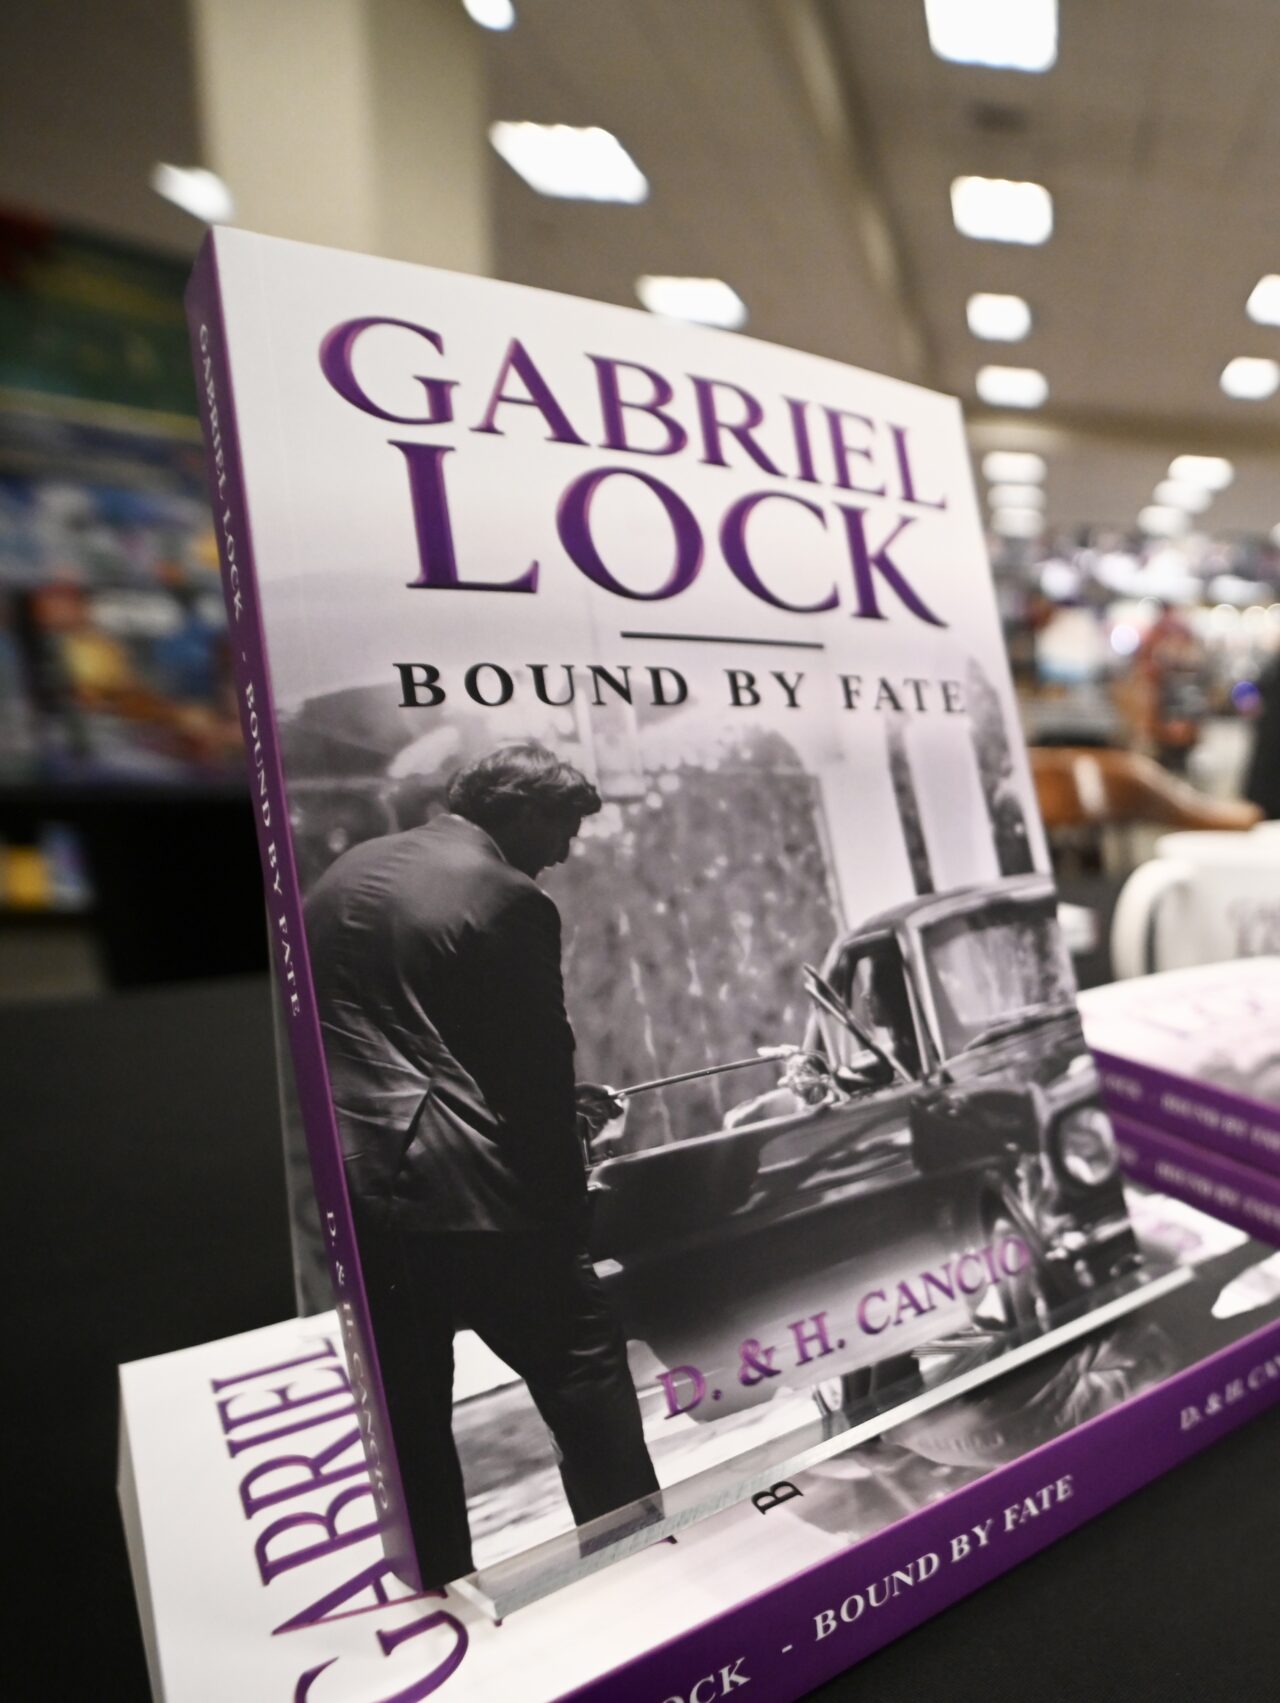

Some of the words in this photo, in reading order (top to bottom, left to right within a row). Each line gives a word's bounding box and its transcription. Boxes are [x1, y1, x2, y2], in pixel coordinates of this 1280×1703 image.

[319, 315, 948, 511] GABRIEL
[387, 439, 950, 628] LOCK
[199, 323, 226, 500] GABRIEL
[222, 508, 243, 623] LOCK
[245, 682, 271, 828] BOUND
[267, 841, 282, 895] BY
[278, 914, 300, 1016] FATE
[393, 661, 689, 709] BOUND
[724, 669, 805, 709] BY
[838, 673, 966, 714] FATE
[655, 1364, 723, 1420] D.
[737, 1338, 782, 1387] &
[787, 1311, 846, 1367] H.
[857, 1234, 1031, 1335] CANCIO
[813, 1552, 940, 1641] BOUND
[950, 1519, 994, 1563] BY
[1003, 1474, 1075, 1532] FATE
